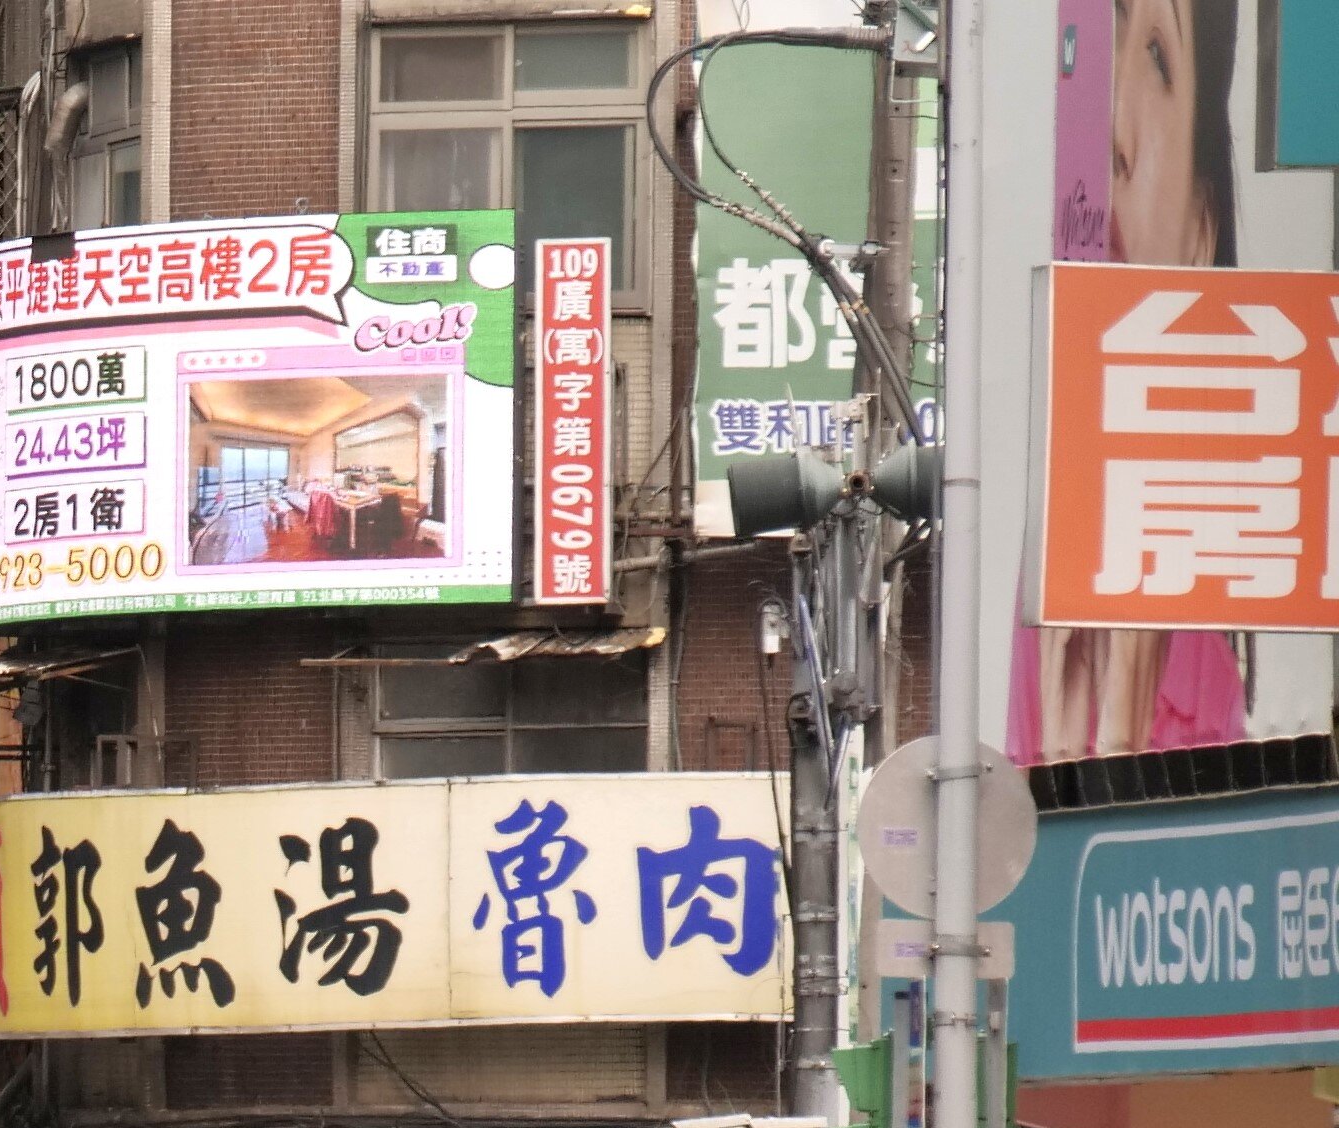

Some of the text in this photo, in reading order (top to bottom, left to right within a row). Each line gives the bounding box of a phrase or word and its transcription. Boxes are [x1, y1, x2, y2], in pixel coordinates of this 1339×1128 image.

[375, 228, 447, 256] 住商
[378, 261, 445, 277] 不動產
[354, 304, 475, 351] Cool!
[15, 351, 126, 404] 1800萬
[1101, 291, 1339, 436] 台
[15, 417, 126, 467] 24.43坪
[14, 487, 125, 538] 2房1衛
[1094, 456, 1339, 599] 房
[473, 798, 780, 998] 魯肉
[1278, 866, 1339, 980] 屈臣
[1095, 877, 1256, 988] watsons
